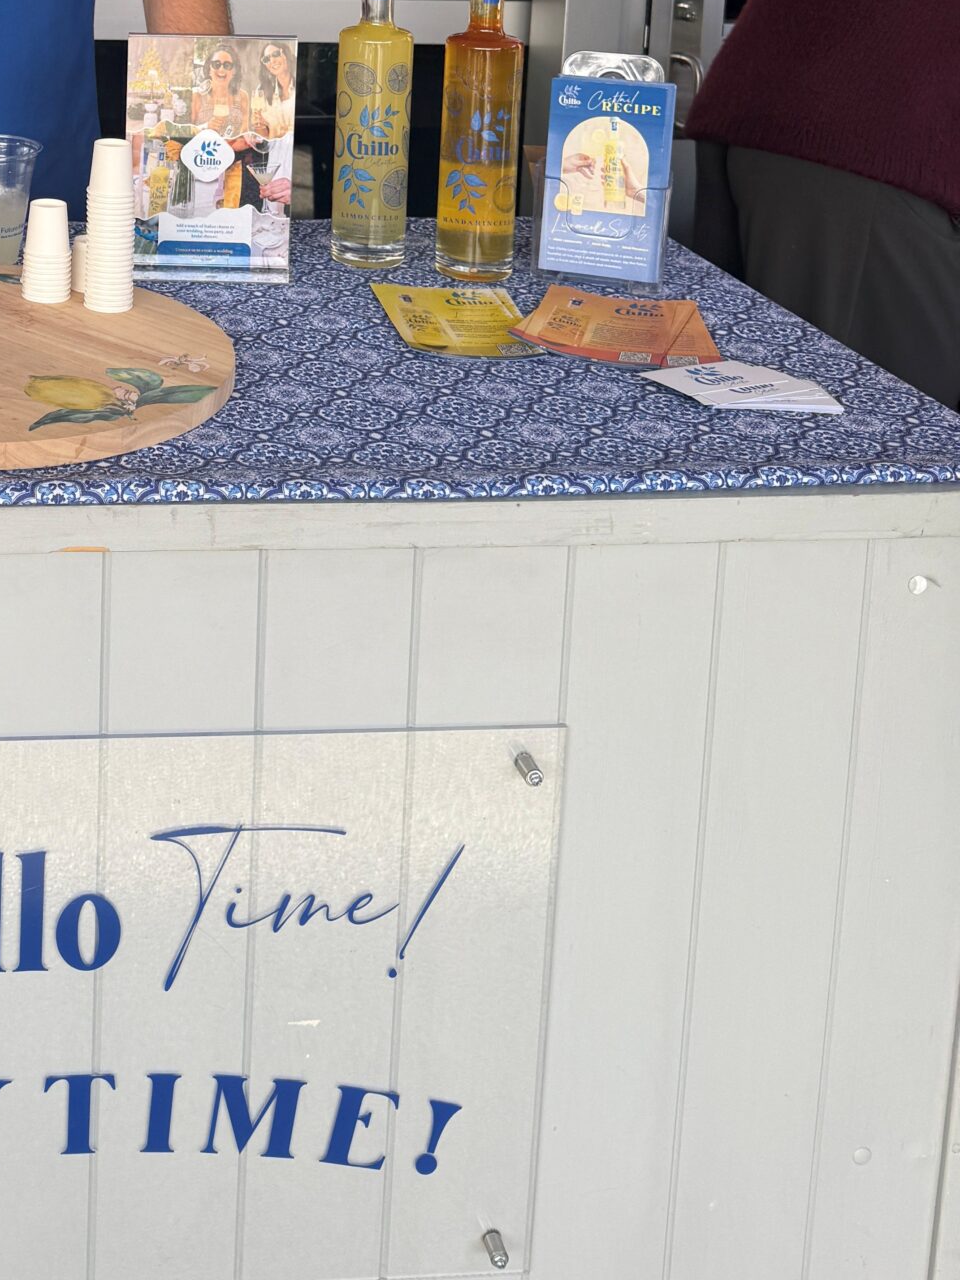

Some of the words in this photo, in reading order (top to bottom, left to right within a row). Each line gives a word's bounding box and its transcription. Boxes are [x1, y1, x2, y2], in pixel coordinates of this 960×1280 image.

[601, 101, 662, 116] RECIPE
[346, 132, 399, 160] Chillo
[455, 135, 511, 165] Chillo
[193, 154, 222, 168] Chillo
[150, 822, 465, 992] Time!
